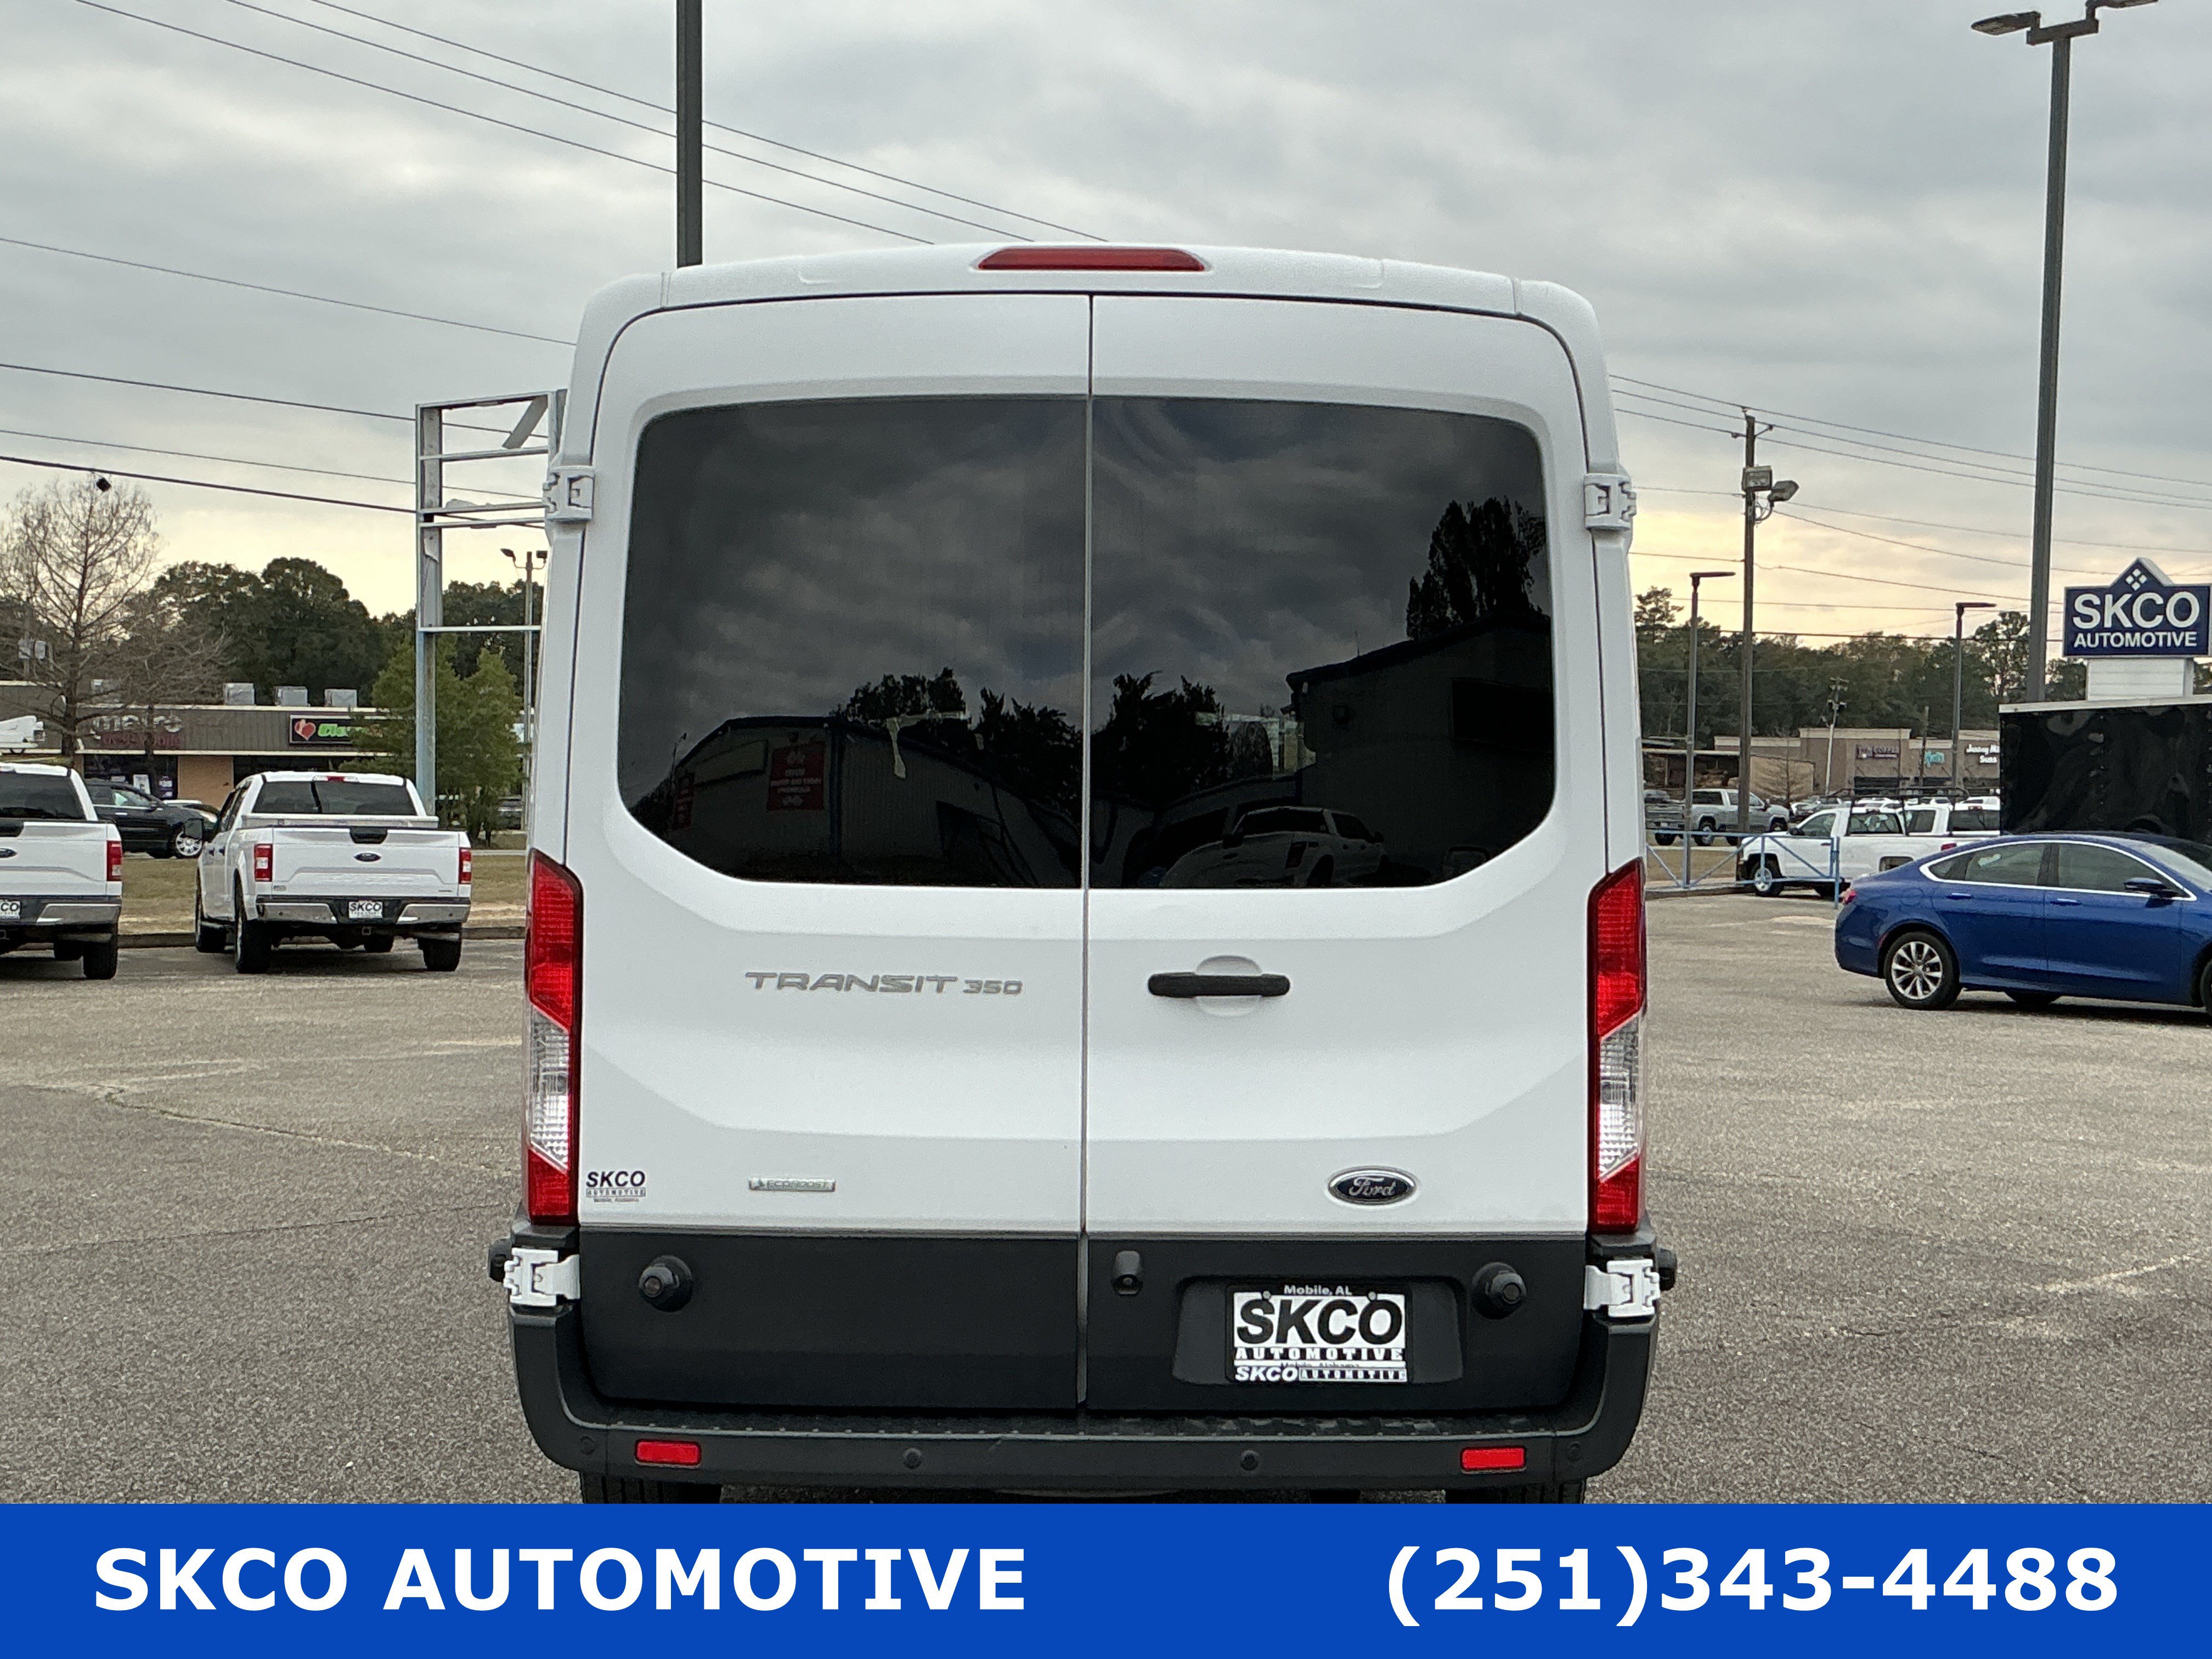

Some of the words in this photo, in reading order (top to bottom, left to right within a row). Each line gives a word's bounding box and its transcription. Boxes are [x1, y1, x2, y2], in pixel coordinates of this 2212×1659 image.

[2073, 591, 2200, 629] SKCO
[2073, 631, 2197, 648] AUTOMOTIVE
[349, 902, 382, 912] SKCO
[744, 970, 958, 994] TRANSIT
[962, 979, 1024, 995] 350
[585, 1170, 646, 1187] SKCO
[1348, 1176, 1397, 1197] Ford
[1283, 1284, 1333, 1296] Mobile,
[1335, 1285, 1353, 1296] AL
[1237, 1298, 1402, 1345] SKCO
[1235, 1347, 1403, 1360] AUTOMOTIVE
[1235, 1365, 1299, 1382] SKCO
[1301, 1368, 1407, 1380] AUTOMOTIVE
